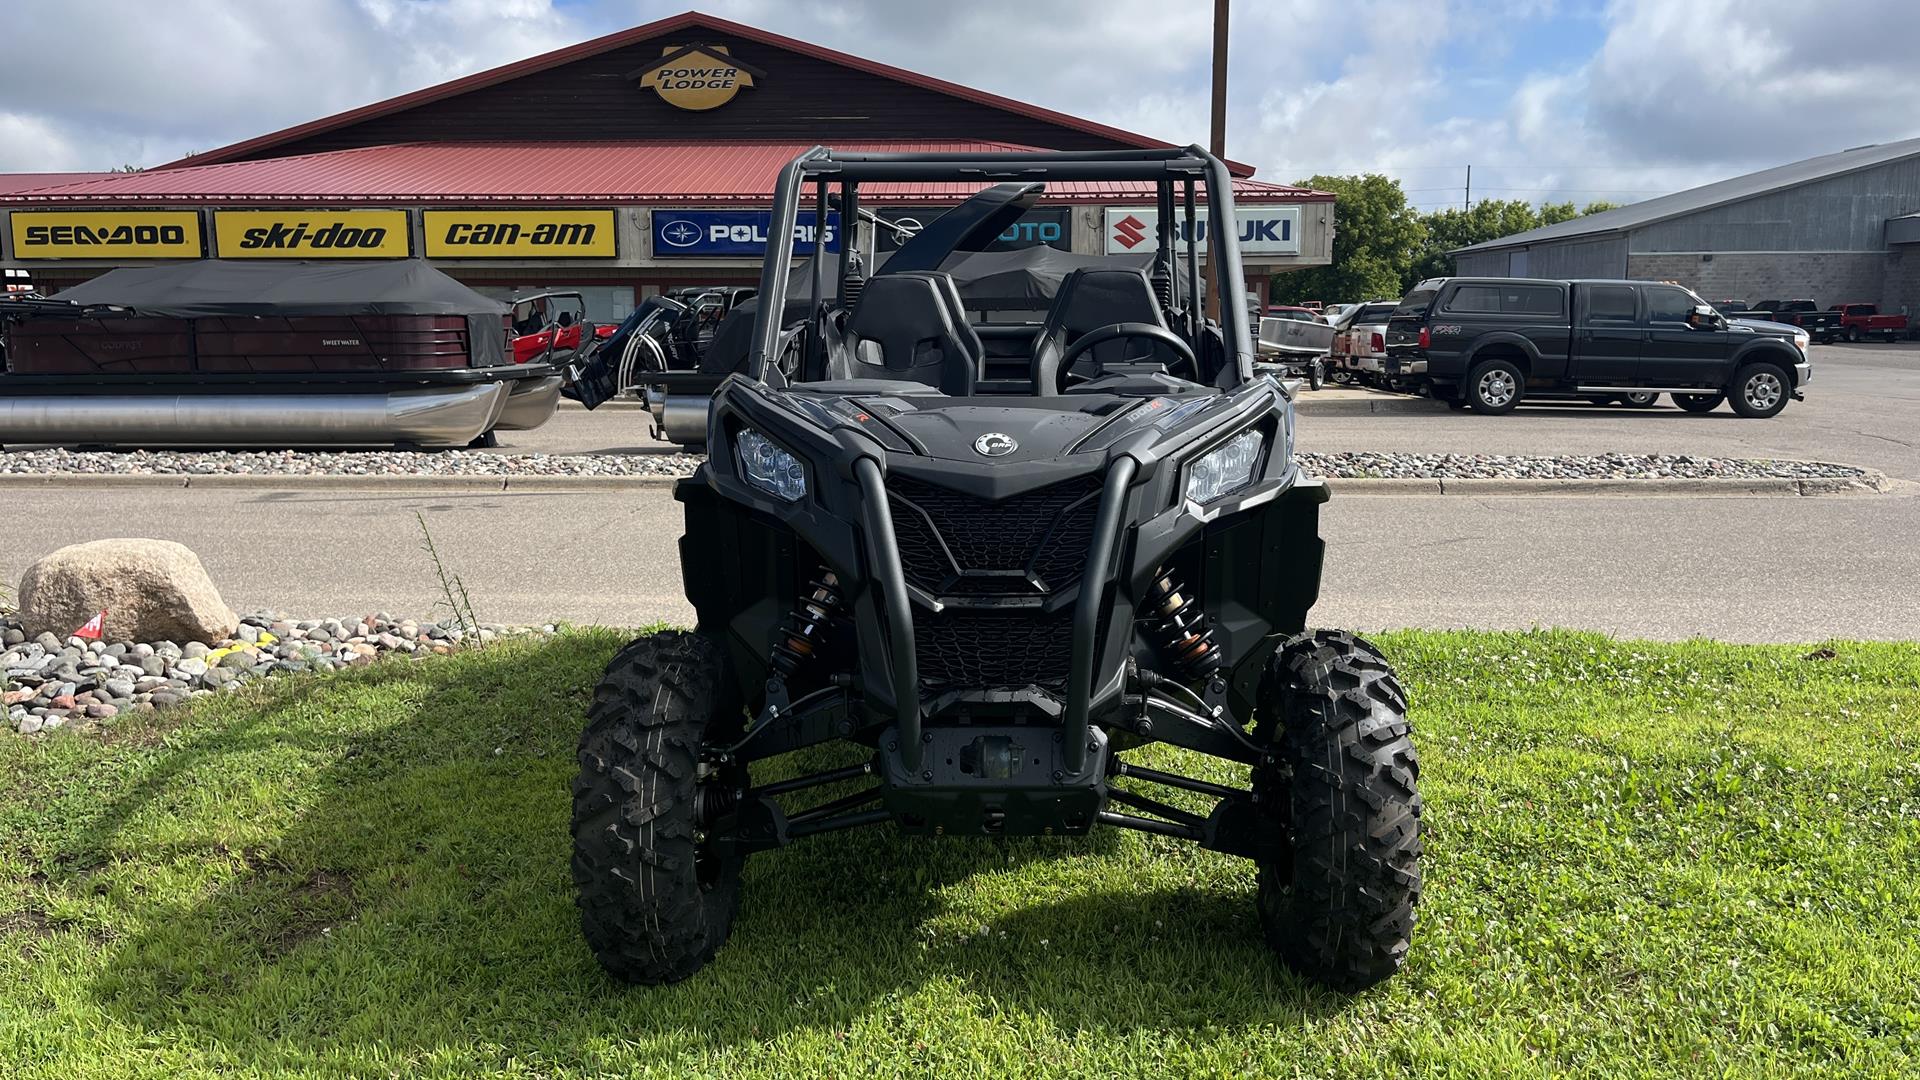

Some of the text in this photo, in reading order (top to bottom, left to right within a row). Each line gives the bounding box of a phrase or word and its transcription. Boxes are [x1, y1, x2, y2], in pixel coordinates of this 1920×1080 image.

[657, 68, 738, 80] POWER
[661, 79, 735, 90] LODGE
[444, 223, 597, 245] can-am
[710, 225, 834, 243] POLRIS
[1126, 400, 1162, 423] 1000R
